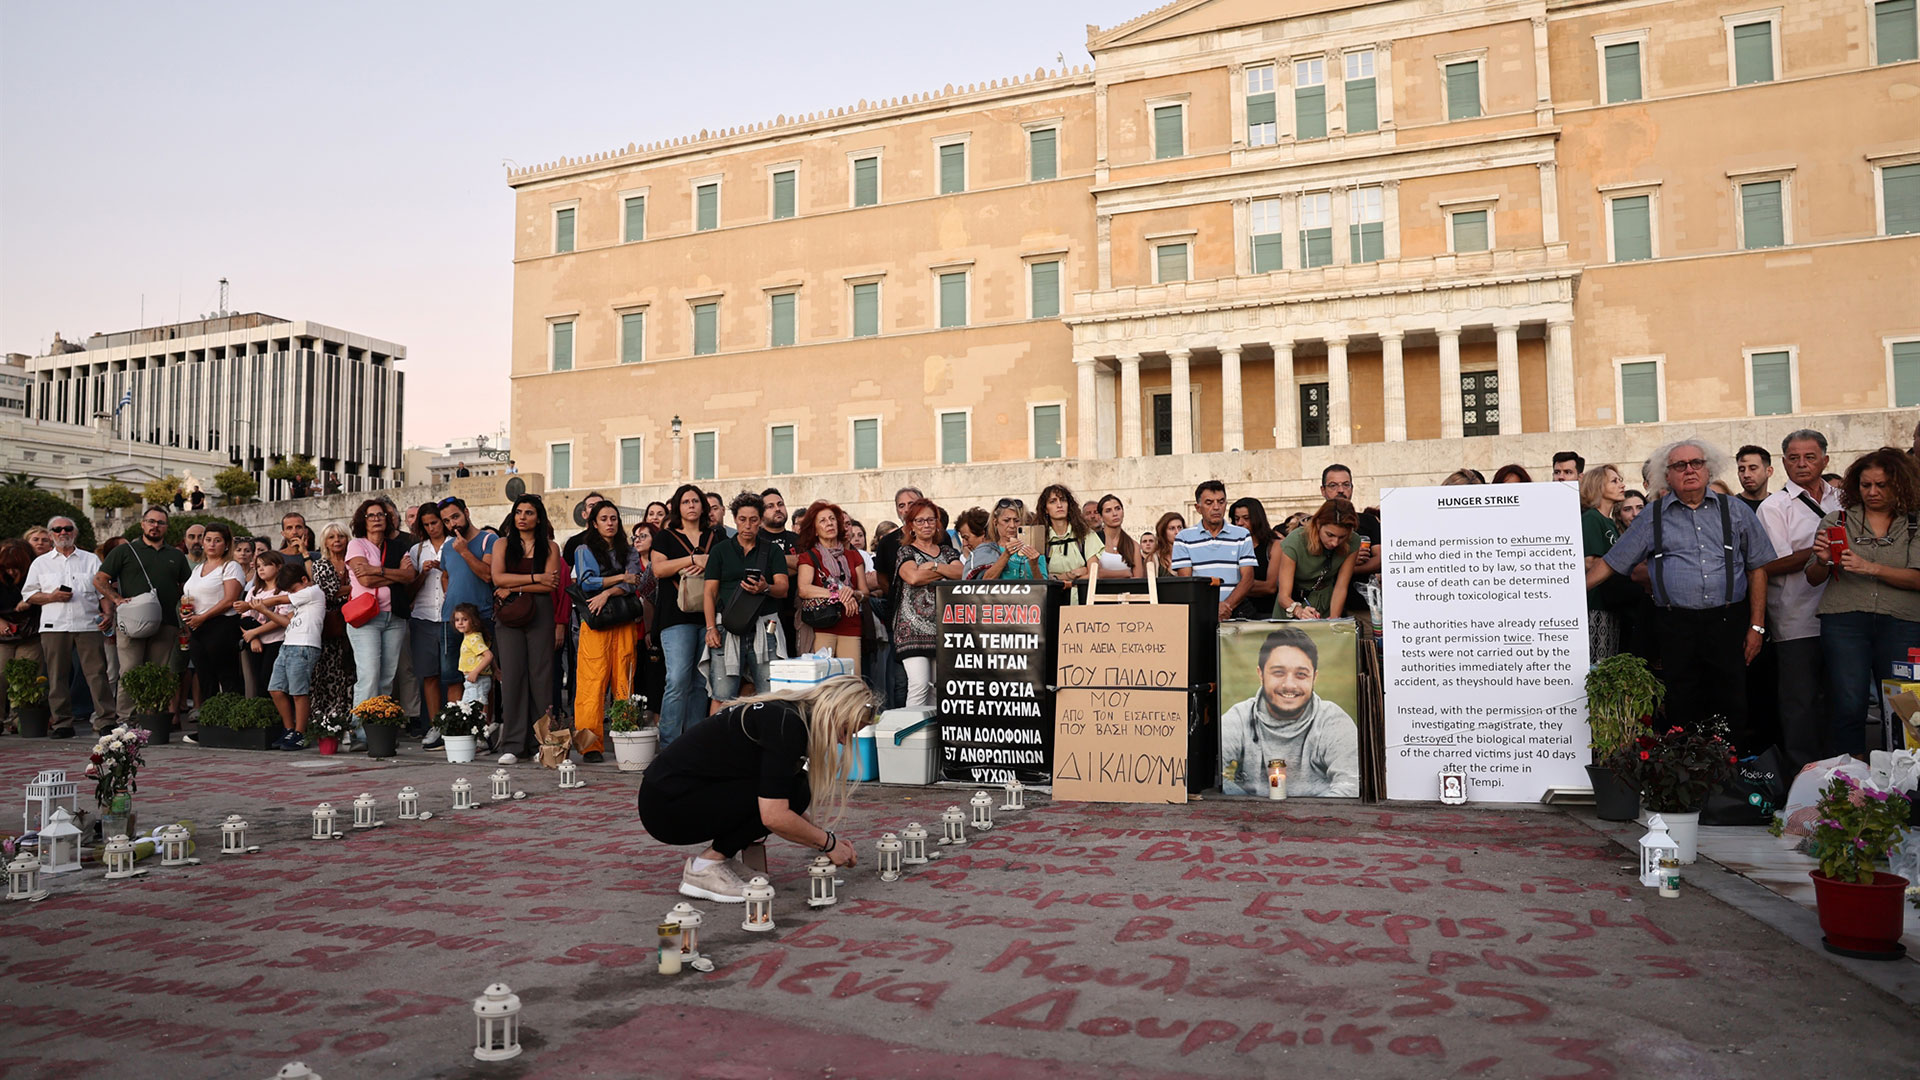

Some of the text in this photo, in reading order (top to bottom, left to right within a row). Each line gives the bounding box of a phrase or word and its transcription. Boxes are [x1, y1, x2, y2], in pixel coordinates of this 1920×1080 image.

[1437, 494, 1519, 506] HUNGER STRIKE
[1390, 534, 1570, 548] I demand permission to exhume my
[1388, 547, 1575, 561] child who died in the Tempi accident,
[1403, 564, 1405, 574] I
[1408, 566, 1424, 574] am
[1427, 563, 1465, 573] entitled
[1468, 563, 1479, 573] to
[1482, 562, 1494, 575] by
[1497, 562, 1516, 573] law,
[1534, 561, 1555, 571] that
[1558, 560, 1575, 570] the
[1396, 580, 1424, 588] cause
[1427, 577, 1438, 587] of
[1440, 577, 1469, 587] death
[1493, 576, 1506, 586] be
[1508, 574, 1569, 585] determined
[1415, 589, 1551, 604] through toxicological tests.
[942, 604, 1041, 624] ΔΕΝ ΞΕΧΝΩ
[1117, 622, 1154, 633] ΤΩΡΑ
[1391, 617, 1578, 630] The authorities have already refused
[943, 633, 1039, 649] ΣΤΑ ΤΕΜΠΗ
[1401, 632, 1568, 646] to grant permission twice. These
[1062, 643, 1167, 653] ΤΗΝ ΑΔΕΙΑ ΕΚΤΑΦΗΣ
[1401, 648, 1425, 657] tests
[1456, 648, 1473, 657] not
[1476, 647, 1512, 657] carried
[1515, 648, 1533, 657] out
[1536, 646, 1549, 659] by
[1552, 646, 1569, 656] the
[954, 654, 1027, 670] ΔΕΝ ΗΤΑΝ
[1401, 661, 1571, 674] authorities immediately after the
[1059, 665, 1177, 686] ΤΟΥ ΠΑΙΔΙΟΥ
[1394, 676, 1439, 687] accident,
[1516, 676, 1540, 686] have
[1543, 676, 1573, 686] been.
[946, 680, 1035, 697] ΟΥΤΕ ΘΥΣΙΑ
[1090, 692, 1130, 707] ΜΟΥ
[941, 699, 1041, 717] ΟΥΤΕ ΑΤΥΧΗΜΑ
[1397, 705, 1437, 716] Instead,
[1440, 705, 1462, 715] with
[1465, 705, 1482, 715] the
[1485, 705, 1543, 717] permission
[1560, 705, 1577, 715] the
[1062, 710, 1181, 721] ΑΠΟ ΤΟΝ ΕΙΣΑΓΓΕΛΕΑ
[1060, 723, 1175, 737] ΠΟΥ ΒΑΣΗ ΝΟΜΟΥ
[1411, 719, 1563, 732] investigating magistrate, they
[942, 726, 1042, 744] ΗΤΑΝ ΔΟΛΟΦΟΝΙΑ
[1403, 734, 1572, 746] destroyed the biological material
[944, 747, 1044, 764] 57 ΑΝΘΡΩΠΙΝΩΝ
[1400, 748, 1576, 761] of the charred victims just 40 days
[1442, 763, 1531, 773] after the crime in
[971, 769, 1016, 782] ΨΥΧΩΝ
[1470, 777, 1504, 790] Tempi.
[968, 835, 1126, 859] Βάιος
